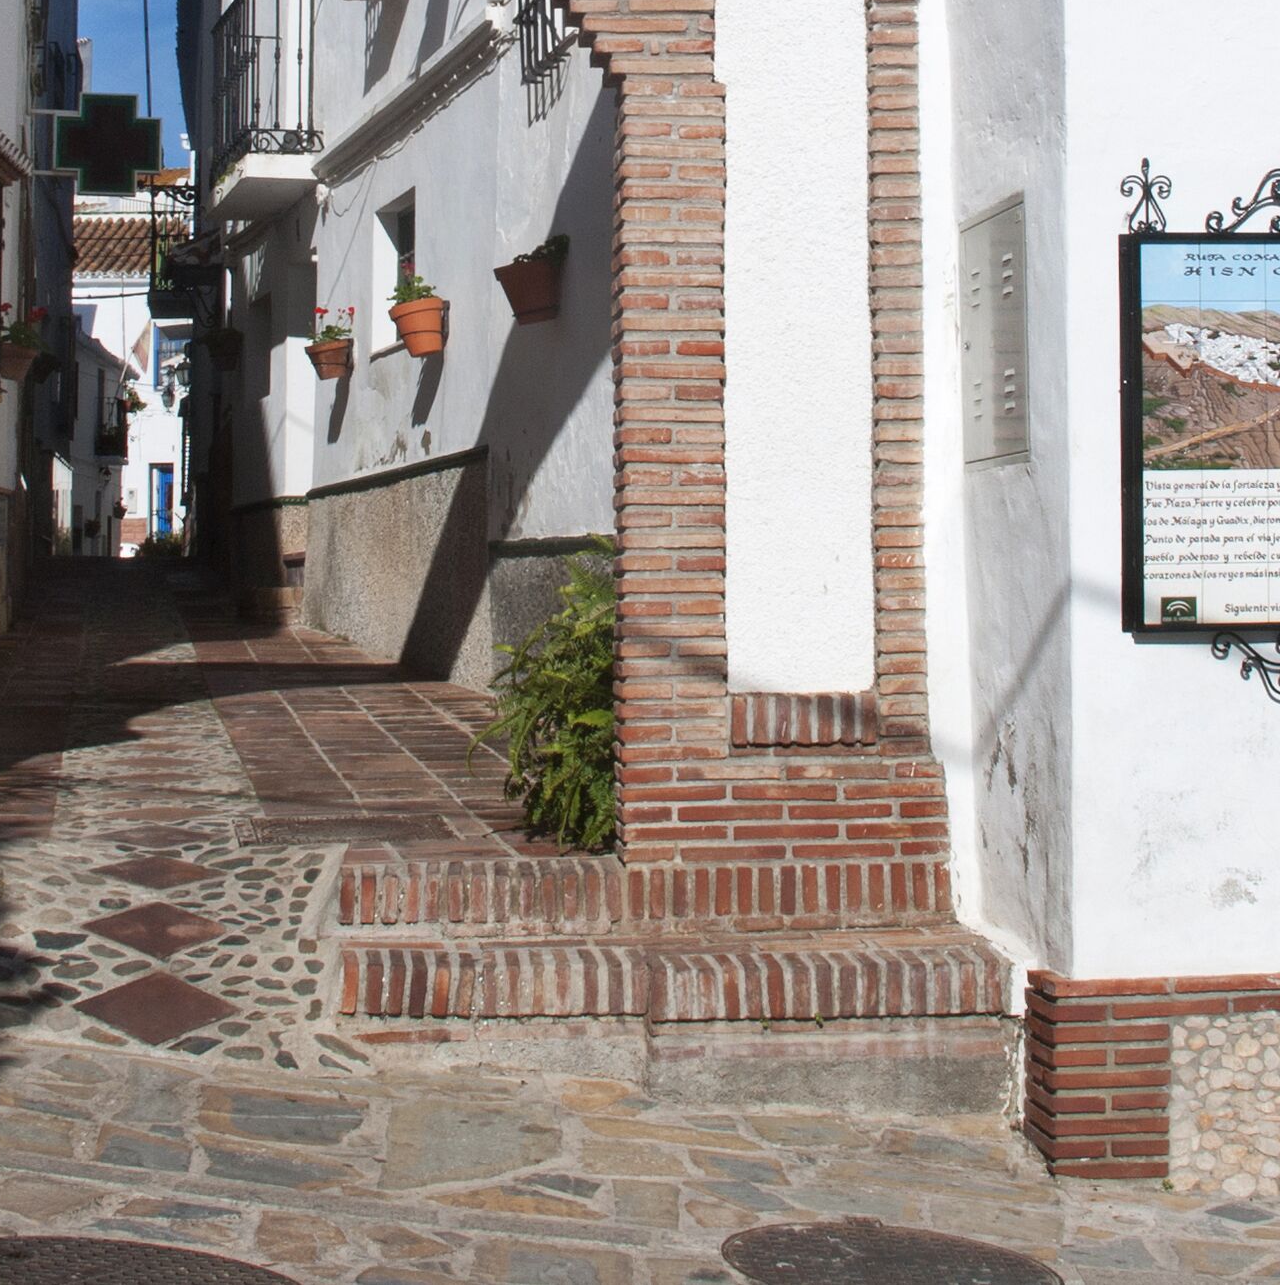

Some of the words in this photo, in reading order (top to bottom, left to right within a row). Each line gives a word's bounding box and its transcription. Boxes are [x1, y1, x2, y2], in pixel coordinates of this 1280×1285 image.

[1184, 253, 1226, 262] RUTA
[1184, 266, 1258, 277] HISN
[1145, 481, 1171, 491] Vista
[1173, 480, 1208, 493] general
[1210, 481, 1220, 489] de
[1222, 480, 1231, 489] la
[1232, 479, 1275, 493] fortaleza
[1144, 498, 1162, 508] Fue
[1164, 498, 1191, 508] Plaza
[1193, 498, 1223, 508] Fuerte
[1144, 516, 1158, 525] los
[1160, 517, 1169, 525] de
[1171, 516, 1207, 529] Málaga
[1253, 516, 1280, 524] dieron
[1144, 534, 1173, 545] Punto
[1175, 534, 1185, 543] de
[1188, 534, 1220, 547] parada
[1222, 536, 1244, 547] para
[1247, 533, 1255, 542] el
[1145, 553, 1174, 563] pueblo
[1177, 552, 1219, 565] poderoso
[1234, 551, 1267, 561] rebelde
[1144, 572, 1191, 580] corazones
[1192, 570, 1201, 579] de
[1203, 571, 1217, 579] los
[1218, 572, 1245, 582] reyes
[1224, 603, 1268, 616] Siguiente
